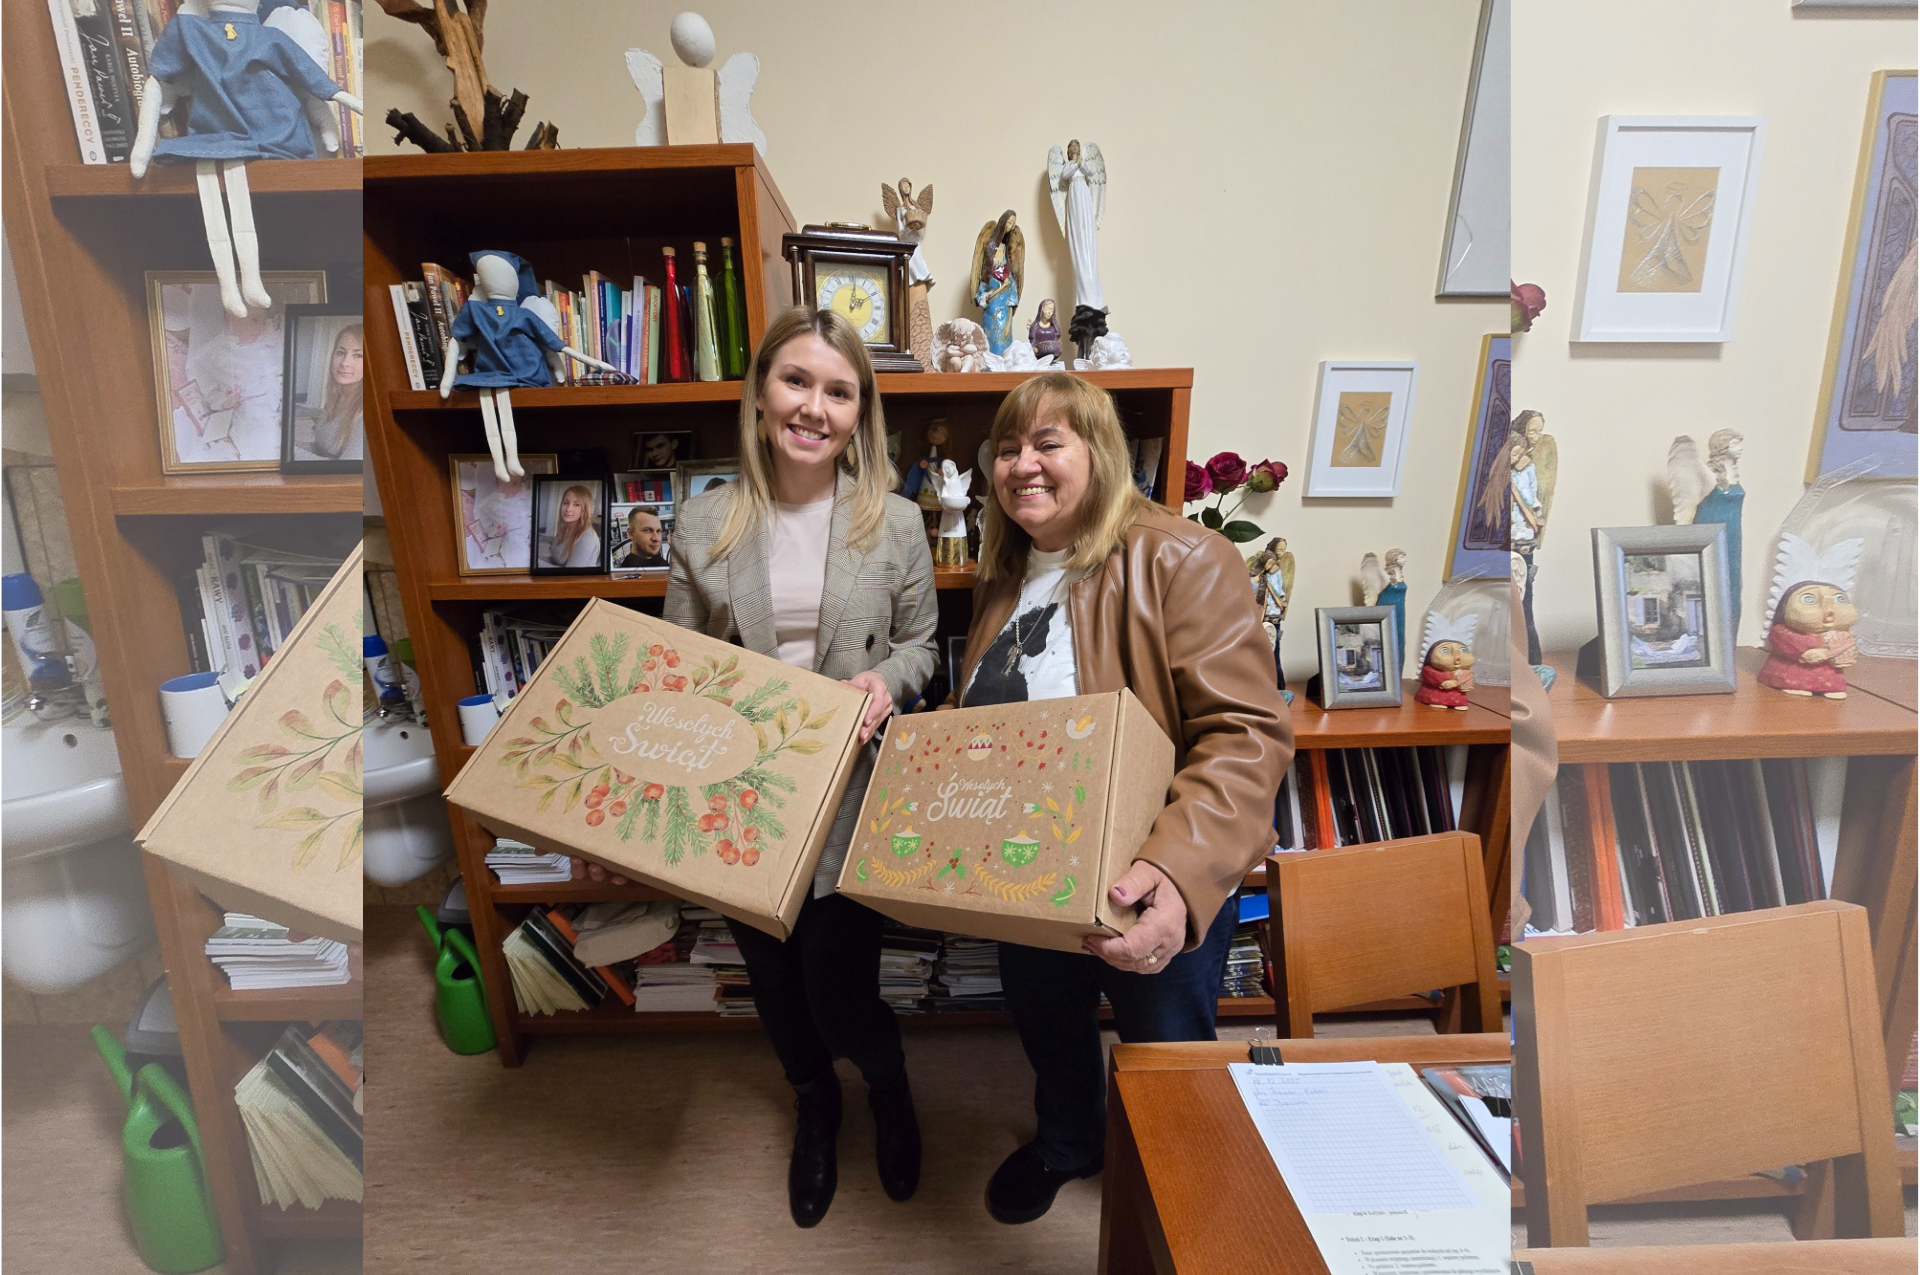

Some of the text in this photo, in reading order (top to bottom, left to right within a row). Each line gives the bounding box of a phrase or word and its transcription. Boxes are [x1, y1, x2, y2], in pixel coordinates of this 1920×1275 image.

[121, 26, 134, 37] II
[71, 67, 95, 143] PENDERECCY
[404, 331, 418, 378] PENDERECCY
[210, 576, 223, 603] KAWY
[608, 715, 727, 773] Świąt
[643, 701, 736, 743] Wesołych
[927, 771, 1013, 825] Świąt
[959, 778, 1006, 793] Wesołych
